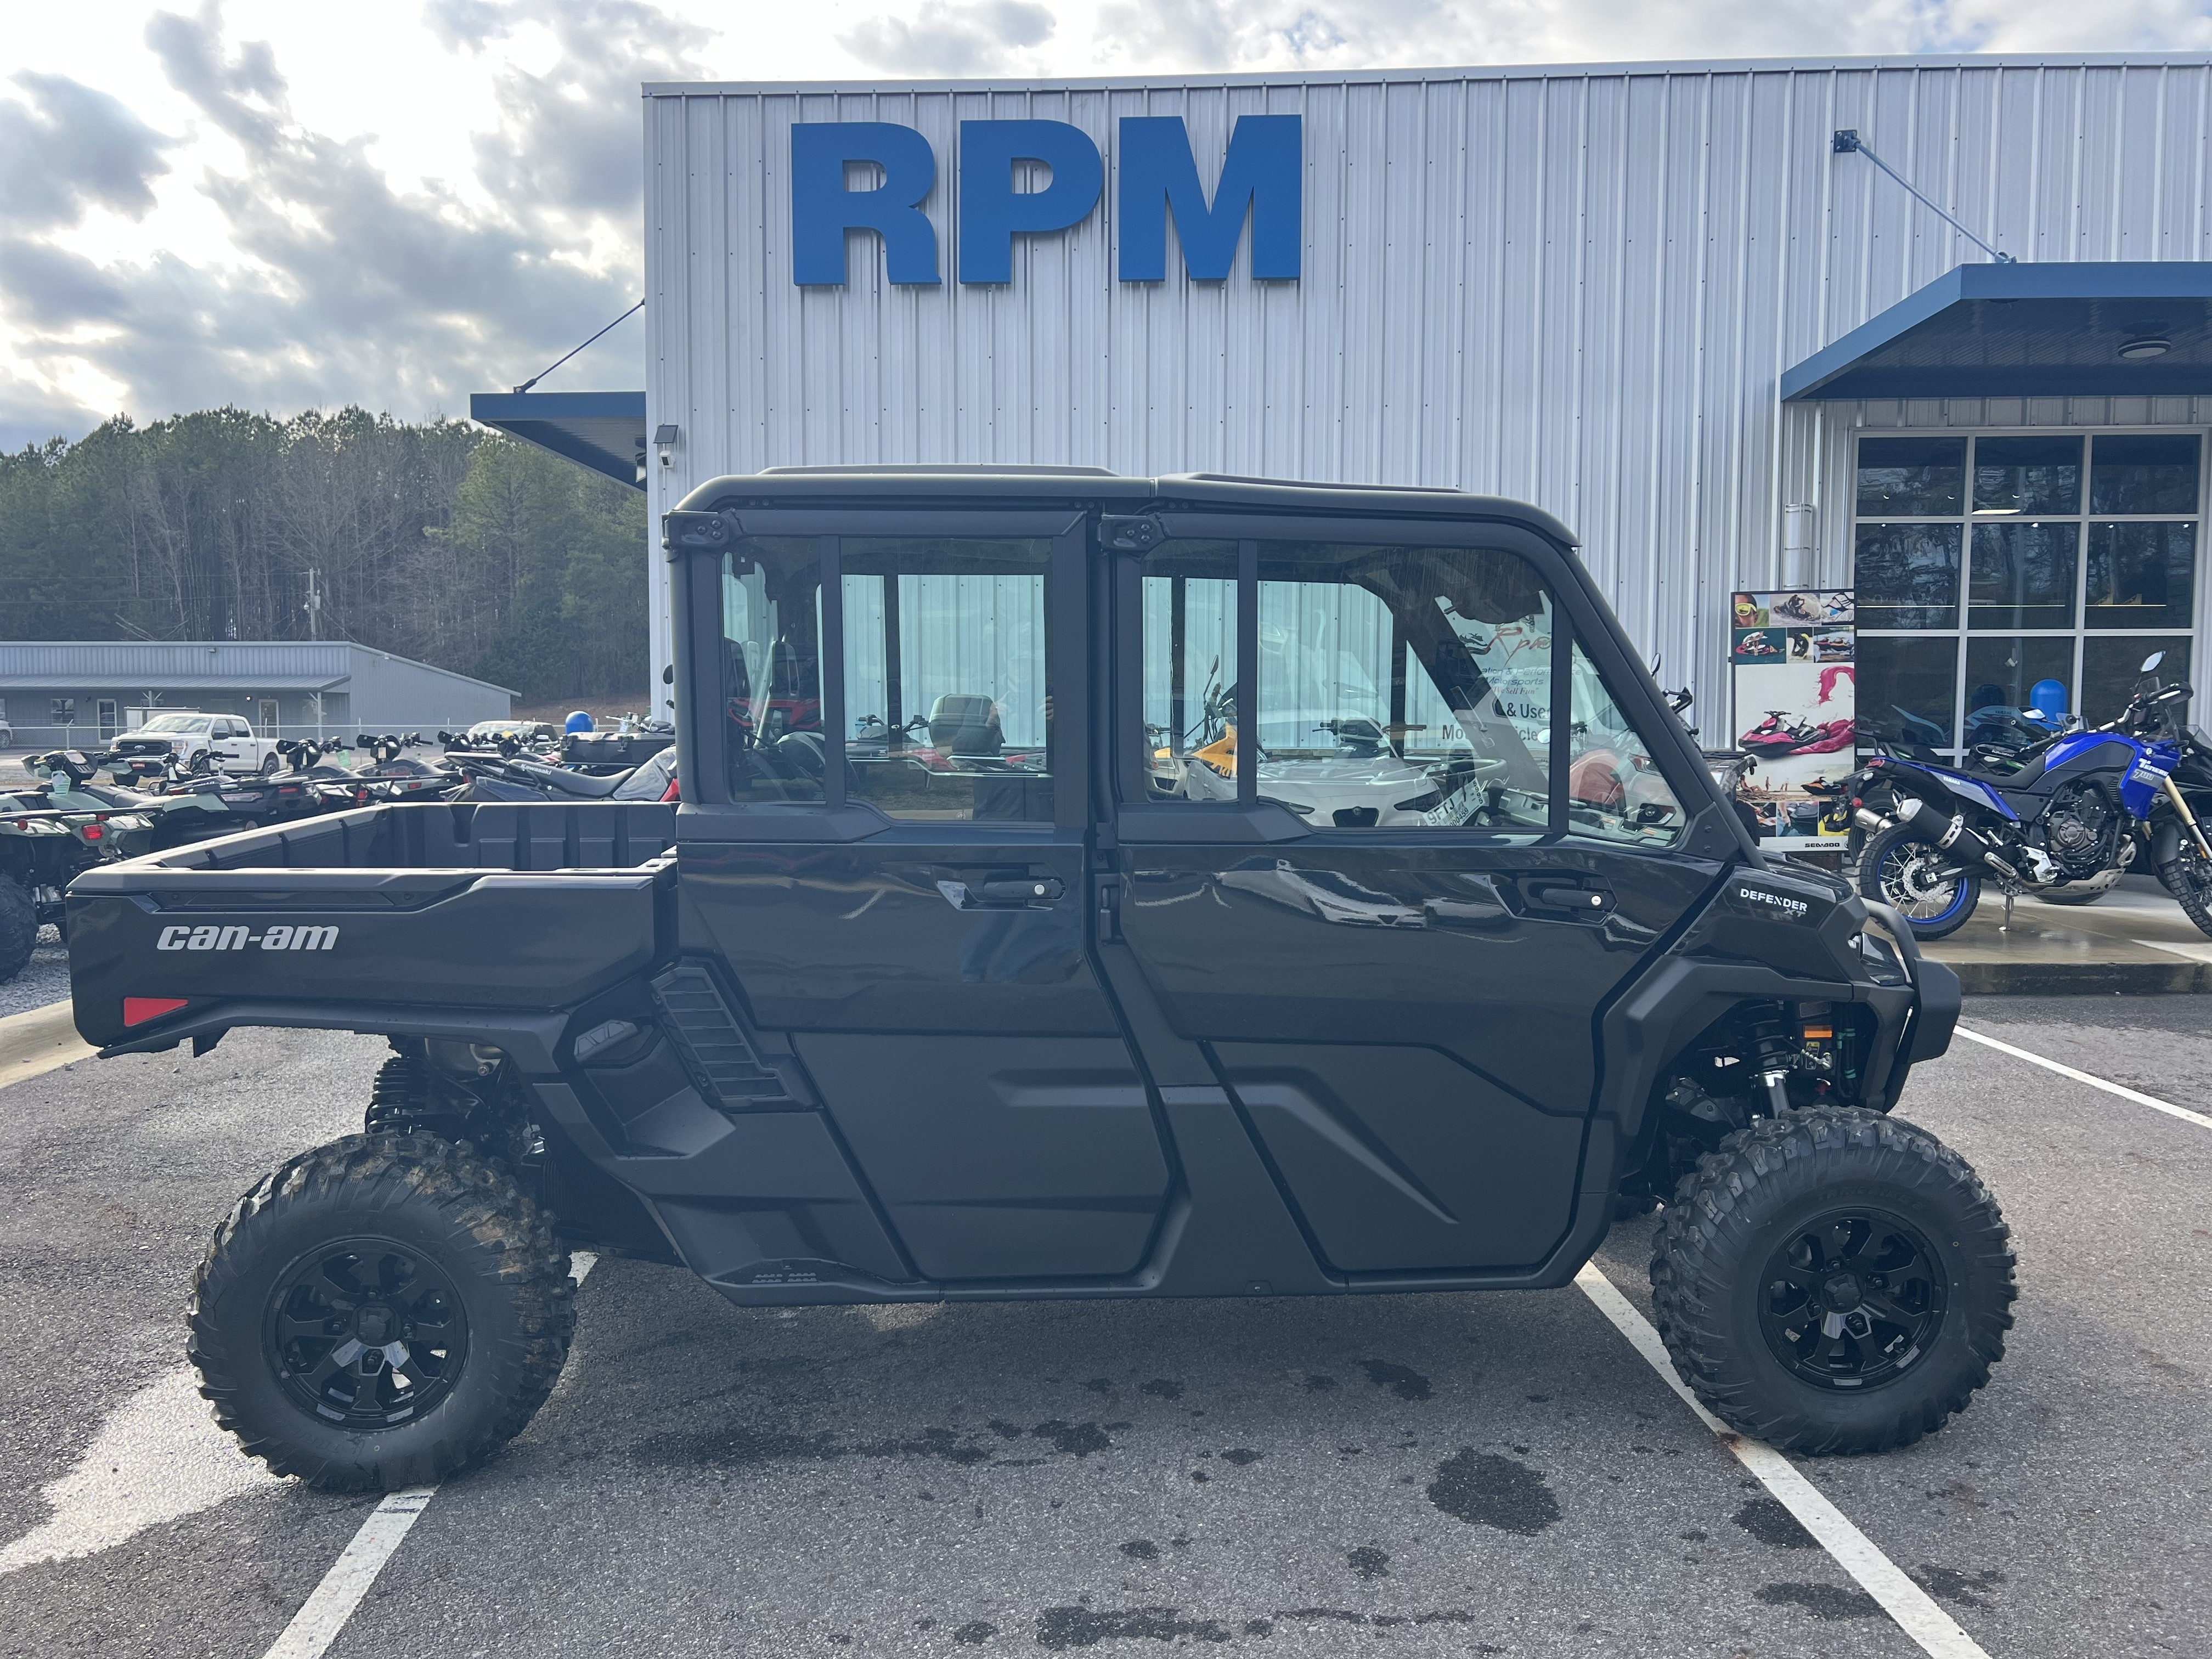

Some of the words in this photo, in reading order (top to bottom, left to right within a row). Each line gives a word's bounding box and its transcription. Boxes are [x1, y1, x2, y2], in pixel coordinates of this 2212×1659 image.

[791, 115, 1302, 286] RPM
[1506, 702, 1517, 718] &
[1520, 703, 1551, 719] Use
[521, 763, 552, 775] Kawasaki
[2132, 769, 2155, 781] 700
[1943, 776, 1961, 786] YAMAHA
[1740, 888, 1808, 912] DEFENDER
[1783, 907, 1807, 917] XT
[156, 925, 339, 950] can-am
